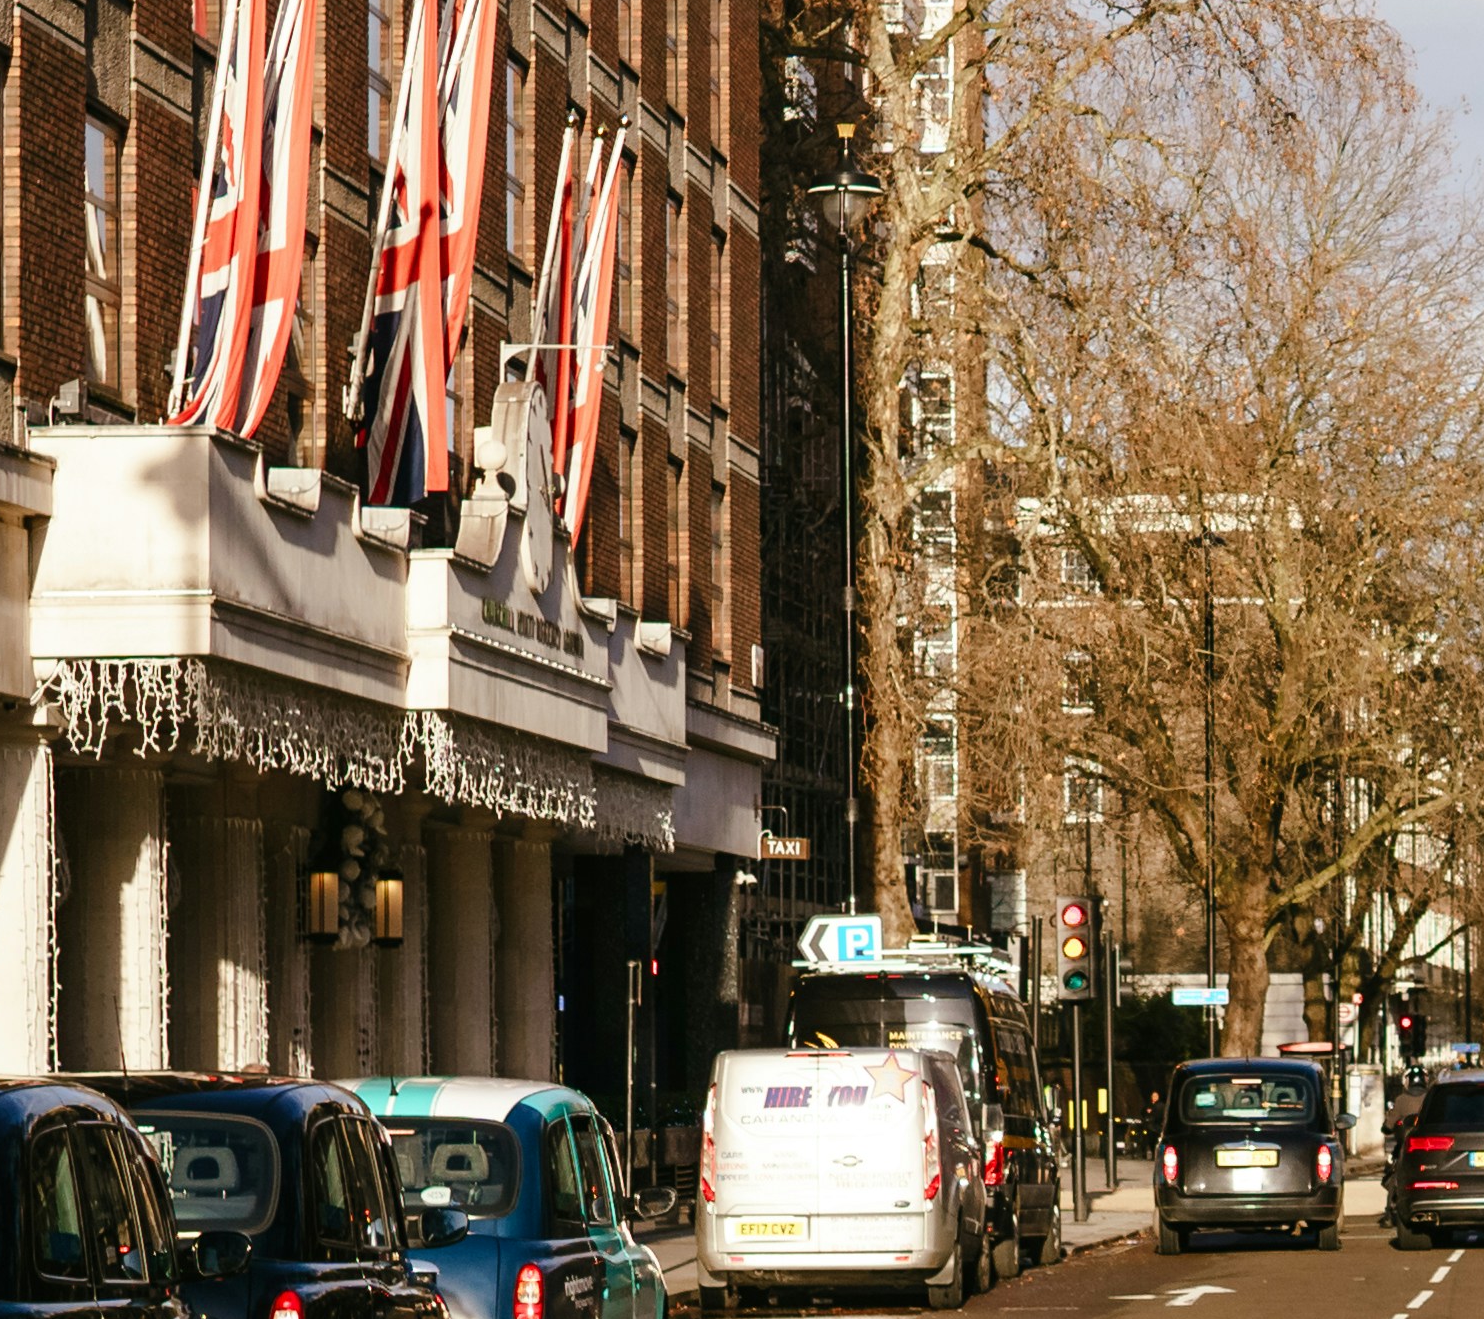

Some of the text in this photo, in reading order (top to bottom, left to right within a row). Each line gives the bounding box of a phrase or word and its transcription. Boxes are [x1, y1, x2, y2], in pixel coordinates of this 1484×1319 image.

[767, 841, 801, 855] TAXI
[845, 928, 869, 959] P
[889, 1031, 963, 1040] MAINTENANCE
[764, 1086, 813, 1109] HIRE
[827, 1086, 869, 1108] YOU
[741, 1223, 795, 1234] EF17 CVZ
